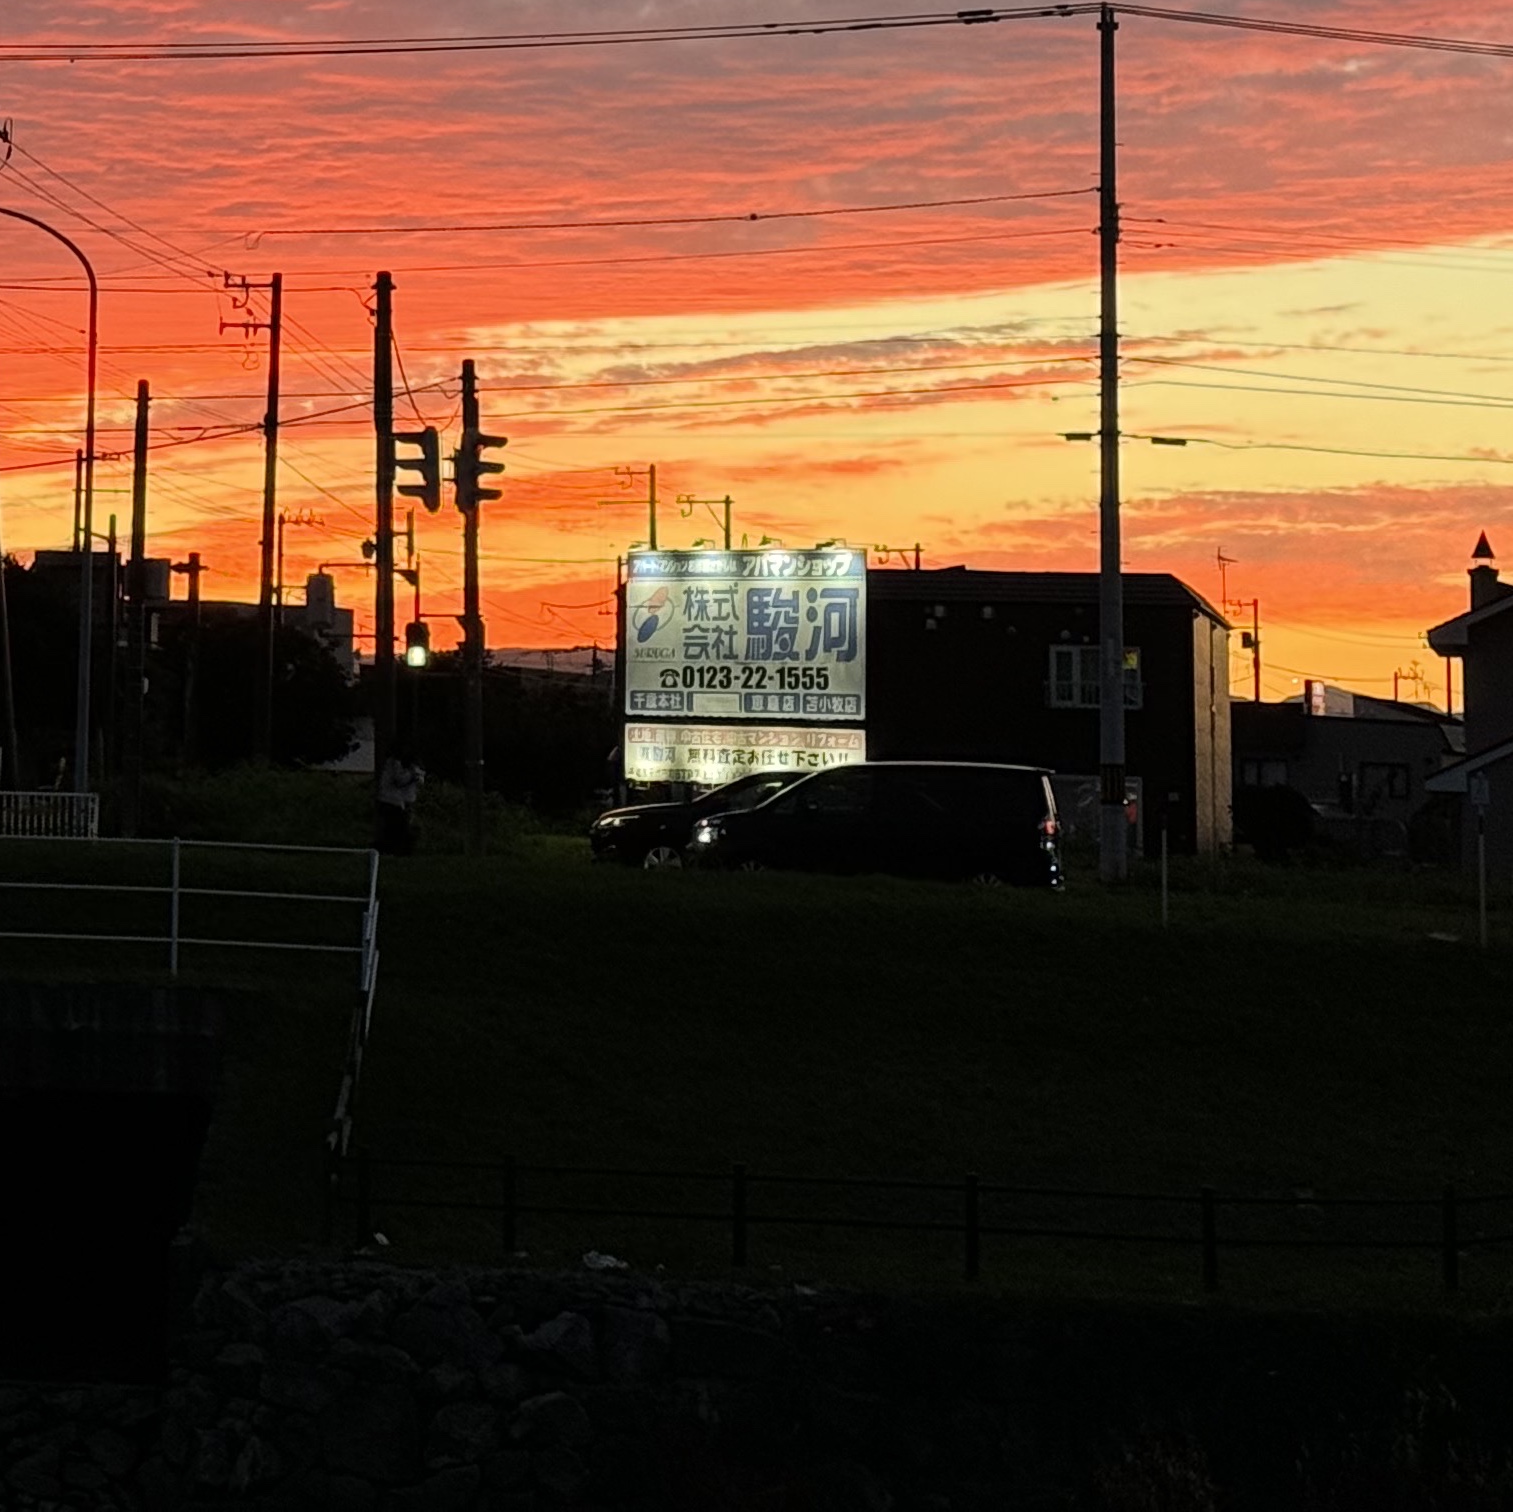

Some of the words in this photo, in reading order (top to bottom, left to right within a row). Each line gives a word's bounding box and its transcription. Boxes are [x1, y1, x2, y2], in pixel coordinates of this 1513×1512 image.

[742, 553, 852, 577] アパマンショップ
[743, 586, 860, 663] 駿河
[806, 733, 860, 749] リフォーム
